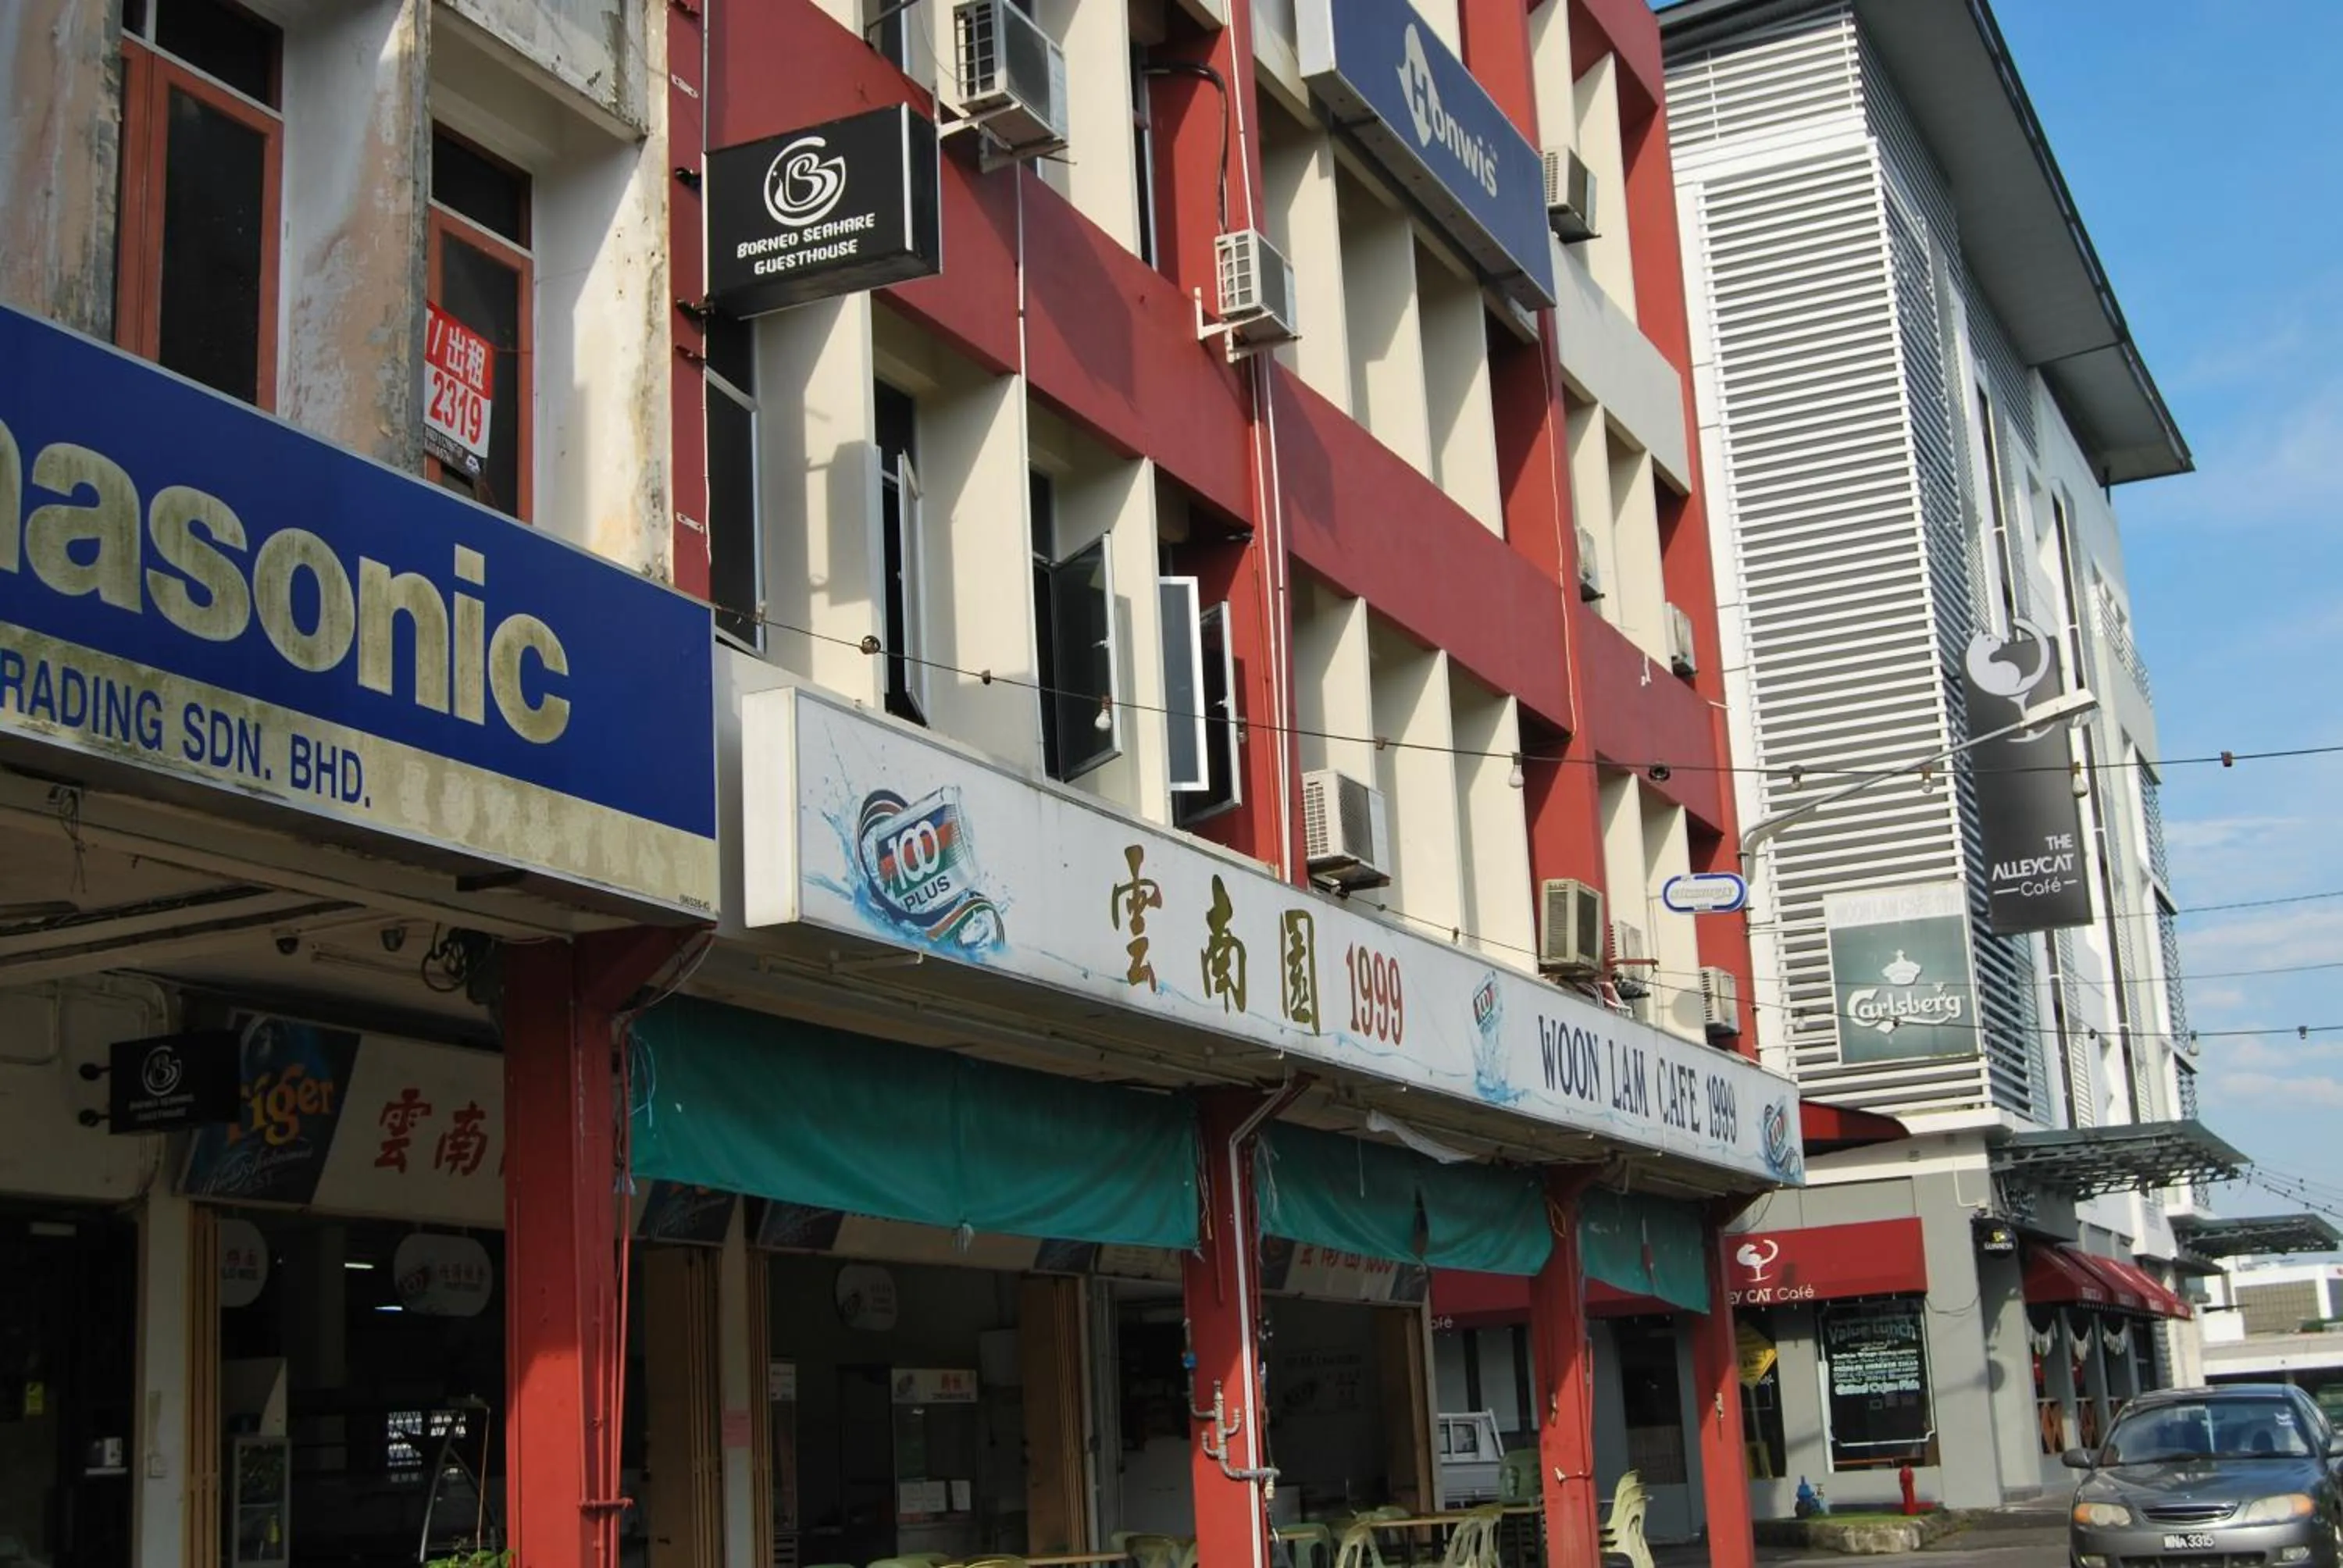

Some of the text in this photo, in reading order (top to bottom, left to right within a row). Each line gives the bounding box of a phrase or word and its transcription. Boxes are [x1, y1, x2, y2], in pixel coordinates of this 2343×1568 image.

[736, 212, 876, 259] BORNEO SEAHARE
[754, 238, 858, 275] GUESTHOUSE
[430, 371, 483, 446] 2319
[0, 416, 571, 743] asonic
[182, 701, 271, 780] SDN.
[290, 733, 371, 808] BHD.
[887, 820, 940, 890] 100
[1992, 853, 2074, 882] ALLEYCAT
[2045, 832, 2074, 850] THE
[904, 875, 951, 912] PLUS
[2020, 875, 2062, 897] Café
[1346, 941, 1404, 1046] 1999
[1847, 985, 1962, 1028] Carlsberg
[228, 1063, 334, 1147] iger
[1539, 1014, 1737, 1144] WOON LAM CAFE 1999
[374, 1089, 505, 1176] 雲南
[1746, 1288, 1772, 1303] CAT
[1777, 1283, 1815, 1301] Café
